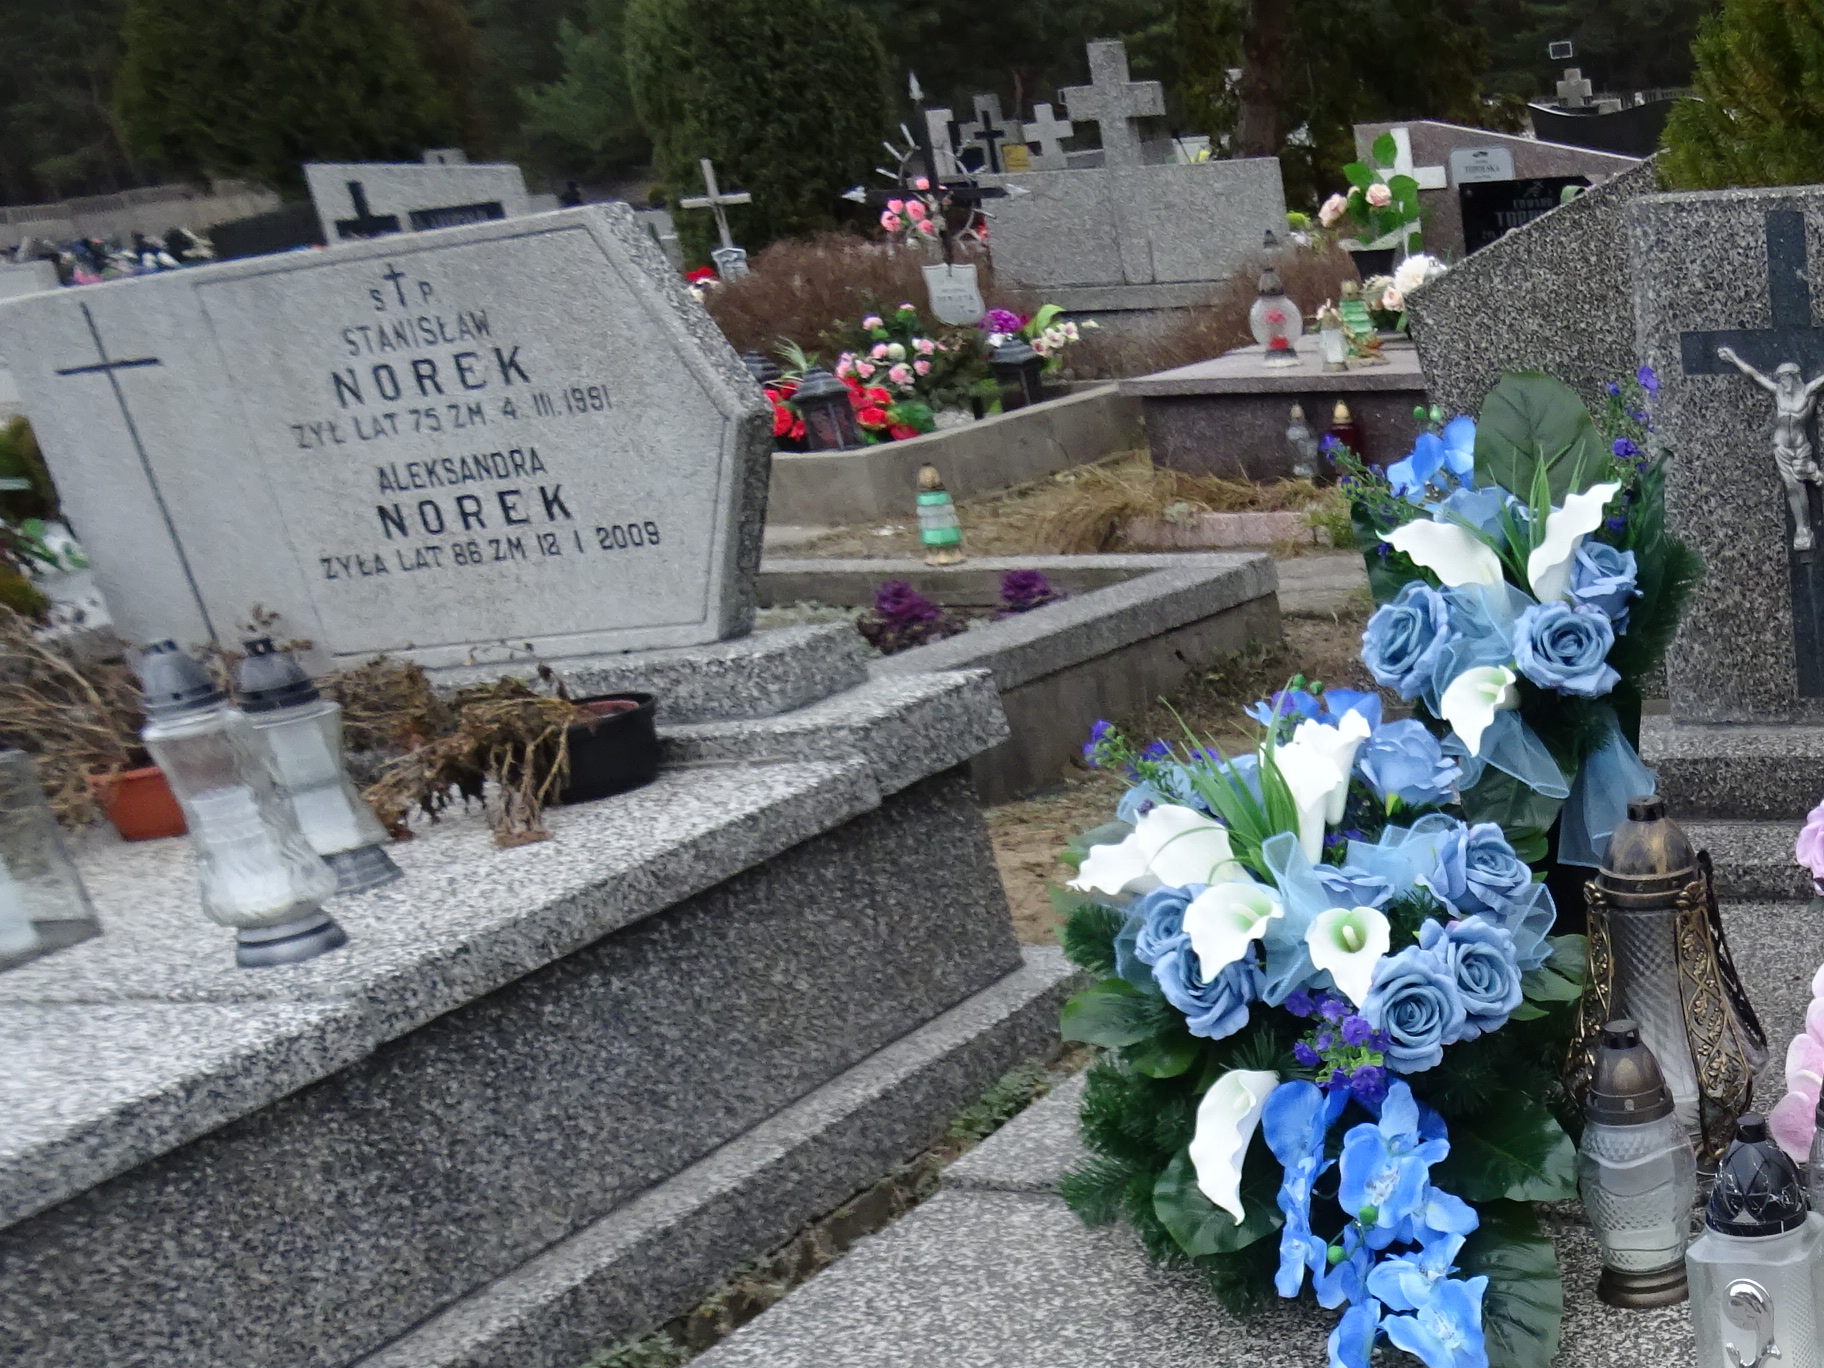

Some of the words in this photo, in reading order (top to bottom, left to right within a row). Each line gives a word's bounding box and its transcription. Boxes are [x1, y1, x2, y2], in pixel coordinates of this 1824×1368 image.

[342, 309, 491, 356] STANISŁAW
[332, 345, 531, 408] NOREK
[351, 412, 399, 440] LAT
[408, 408, 441, 433] 75
[376, 447, 547, 495] ALEKSANDRA
[376, 483, 572, 540] NOREK
[396, 545, 442, 571] LAT
[452, 542, 482, 565] 86
[596, 521, 659, 550] 2009
